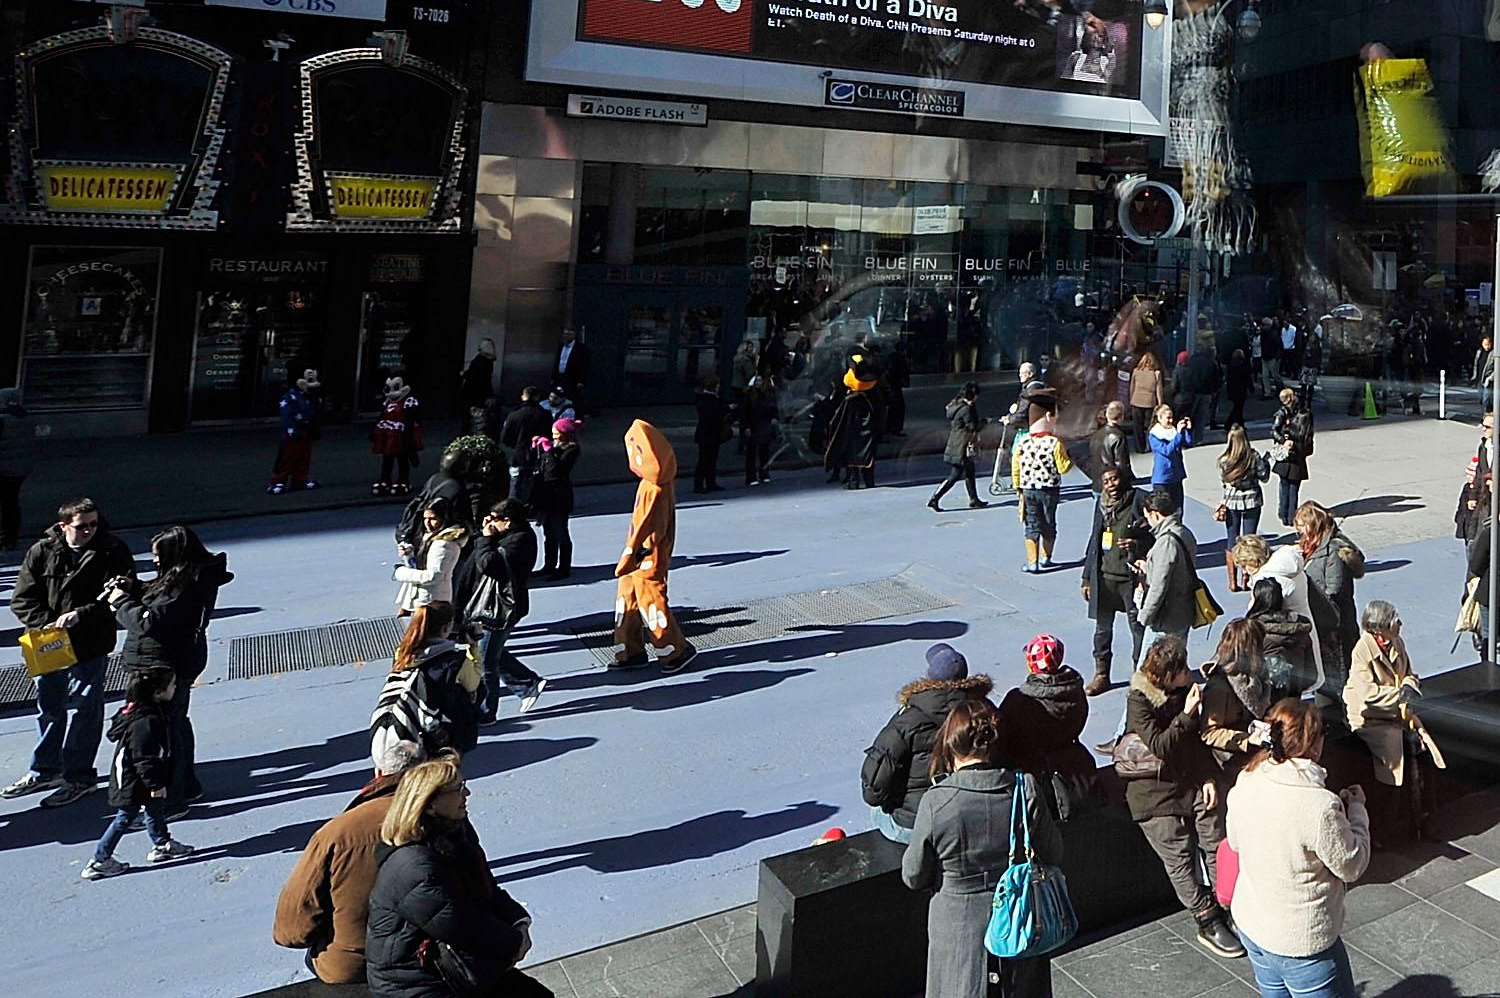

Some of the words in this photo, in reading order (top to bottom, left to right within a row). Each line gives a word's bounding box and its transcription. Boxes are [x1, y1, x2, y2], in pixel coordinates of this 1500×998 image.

[768, 3, 803, 19] Watch
[805, 7, 836, 24] Death
[838, 12, 850, 25] of
[886, 18, 910, 33] CNN
[911, 22, 952, 38] Presents
[954, 28, 995, 45] Saturday
[995, 34, 1019, 48] night
[596, 104, 642, 118] ADOBE
[645, 106, 685, 120] FLASH
[898, 101, 959, 114] SPECTACOLOR
[50, 175, 167, 202] DELICATESSEN
[338, 186, 429, 209] DELICATESSEN
[208, 257, 329, 274] RESTAURANT
[864, 256, 907, 270] BLUE
[912, 257, 938, 271] FIN
[965, 257, 1004, 271] BLUE
[1008, 258, 1031, 271] FIN
[1055, 258, 1091, 272] BLUE
[919, 274, 953, 282] OYSTERS
